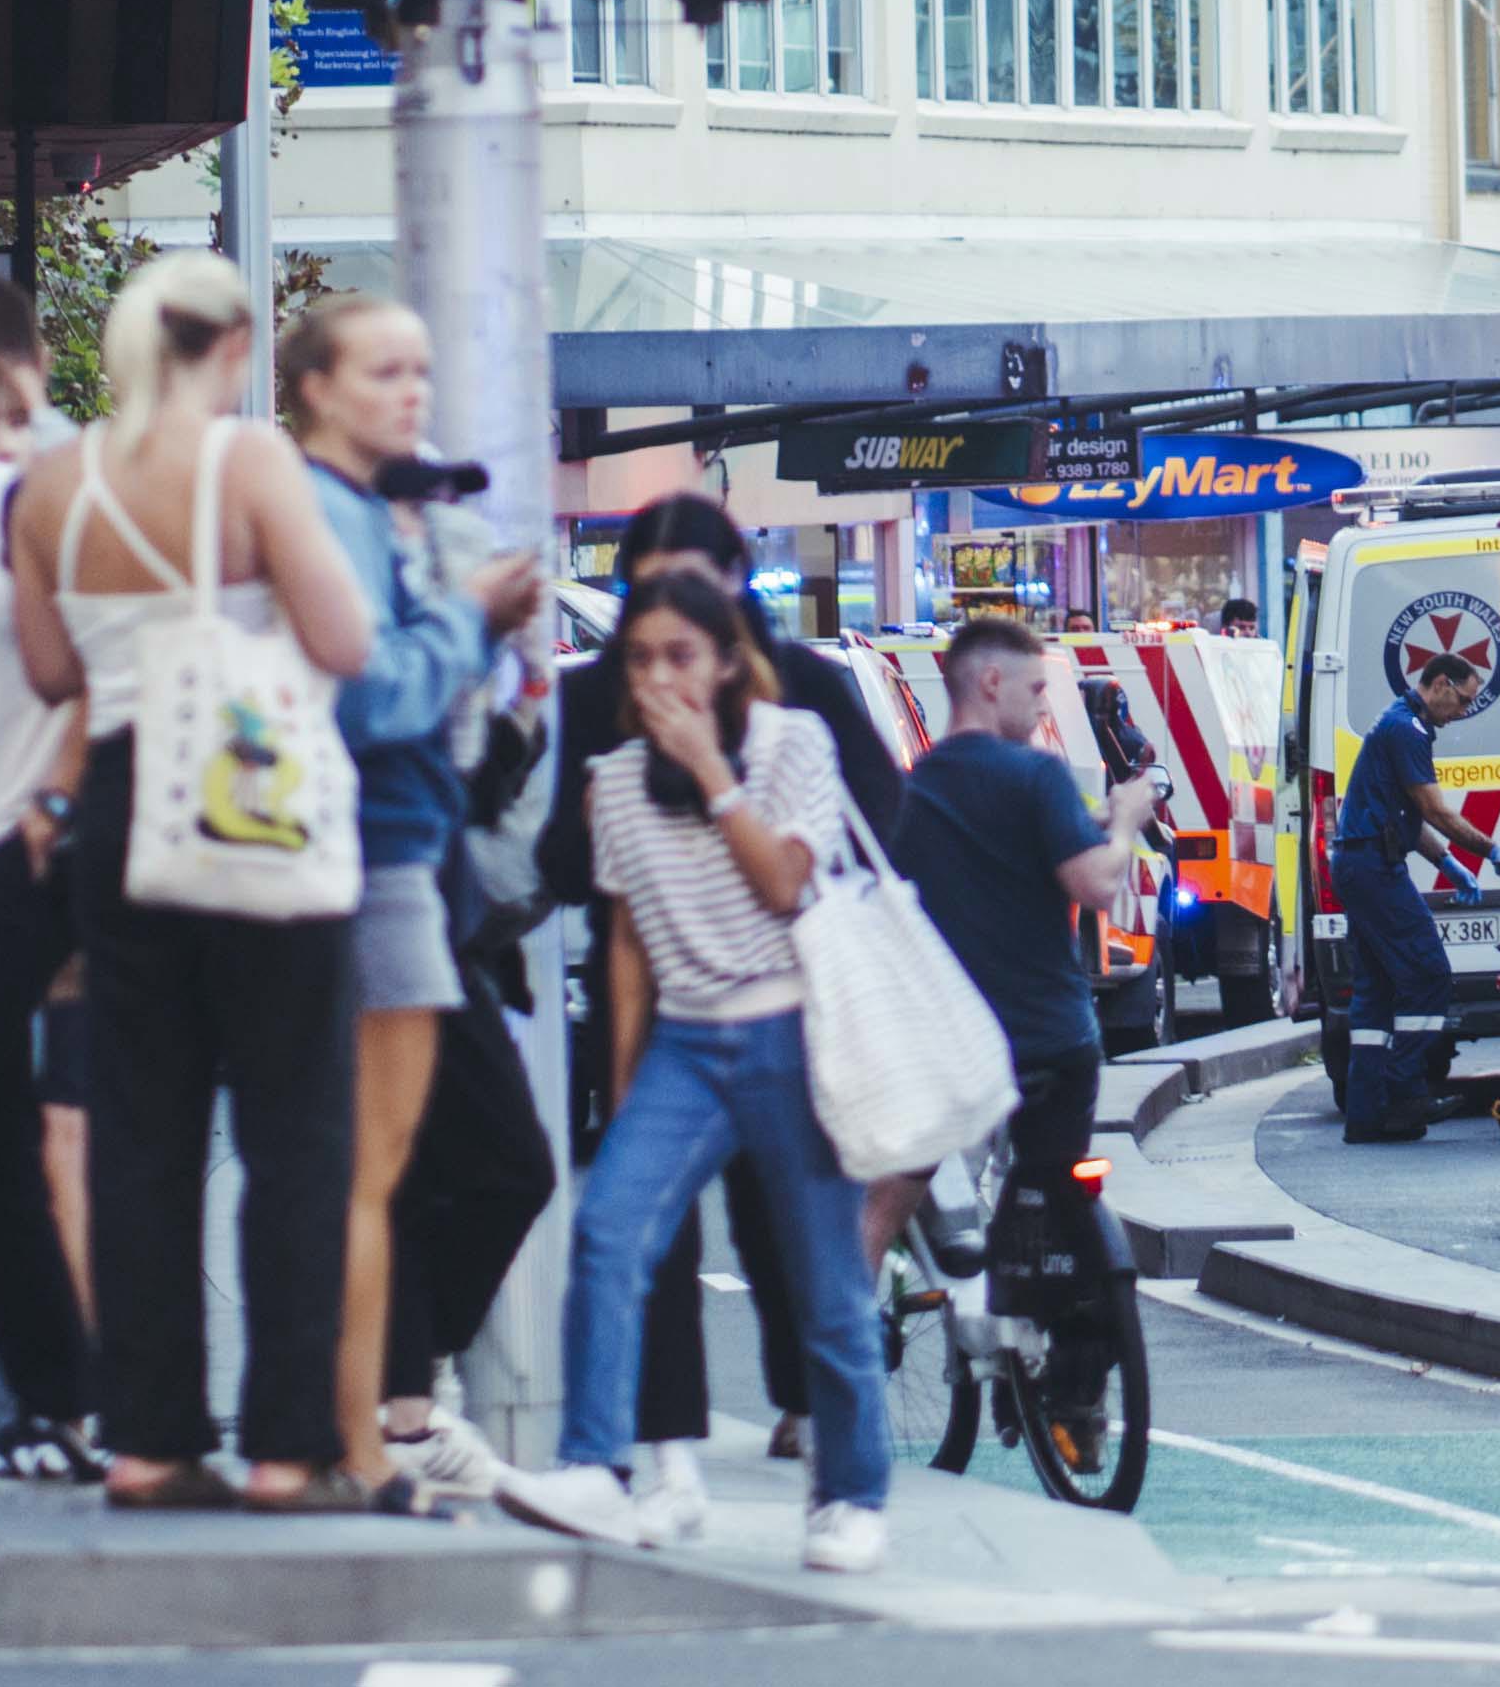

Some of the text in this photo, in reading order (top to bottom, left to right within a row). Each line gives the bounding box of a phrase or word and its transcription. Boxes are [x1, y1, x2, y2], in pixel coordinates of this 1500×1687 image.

[844, 434, 965, 470] SUBWAY
[1067, 436, 1128, 460] design
[1388, 609, 1416, 645] NEW
[1412, 592, 1466, 617] SOUTH
